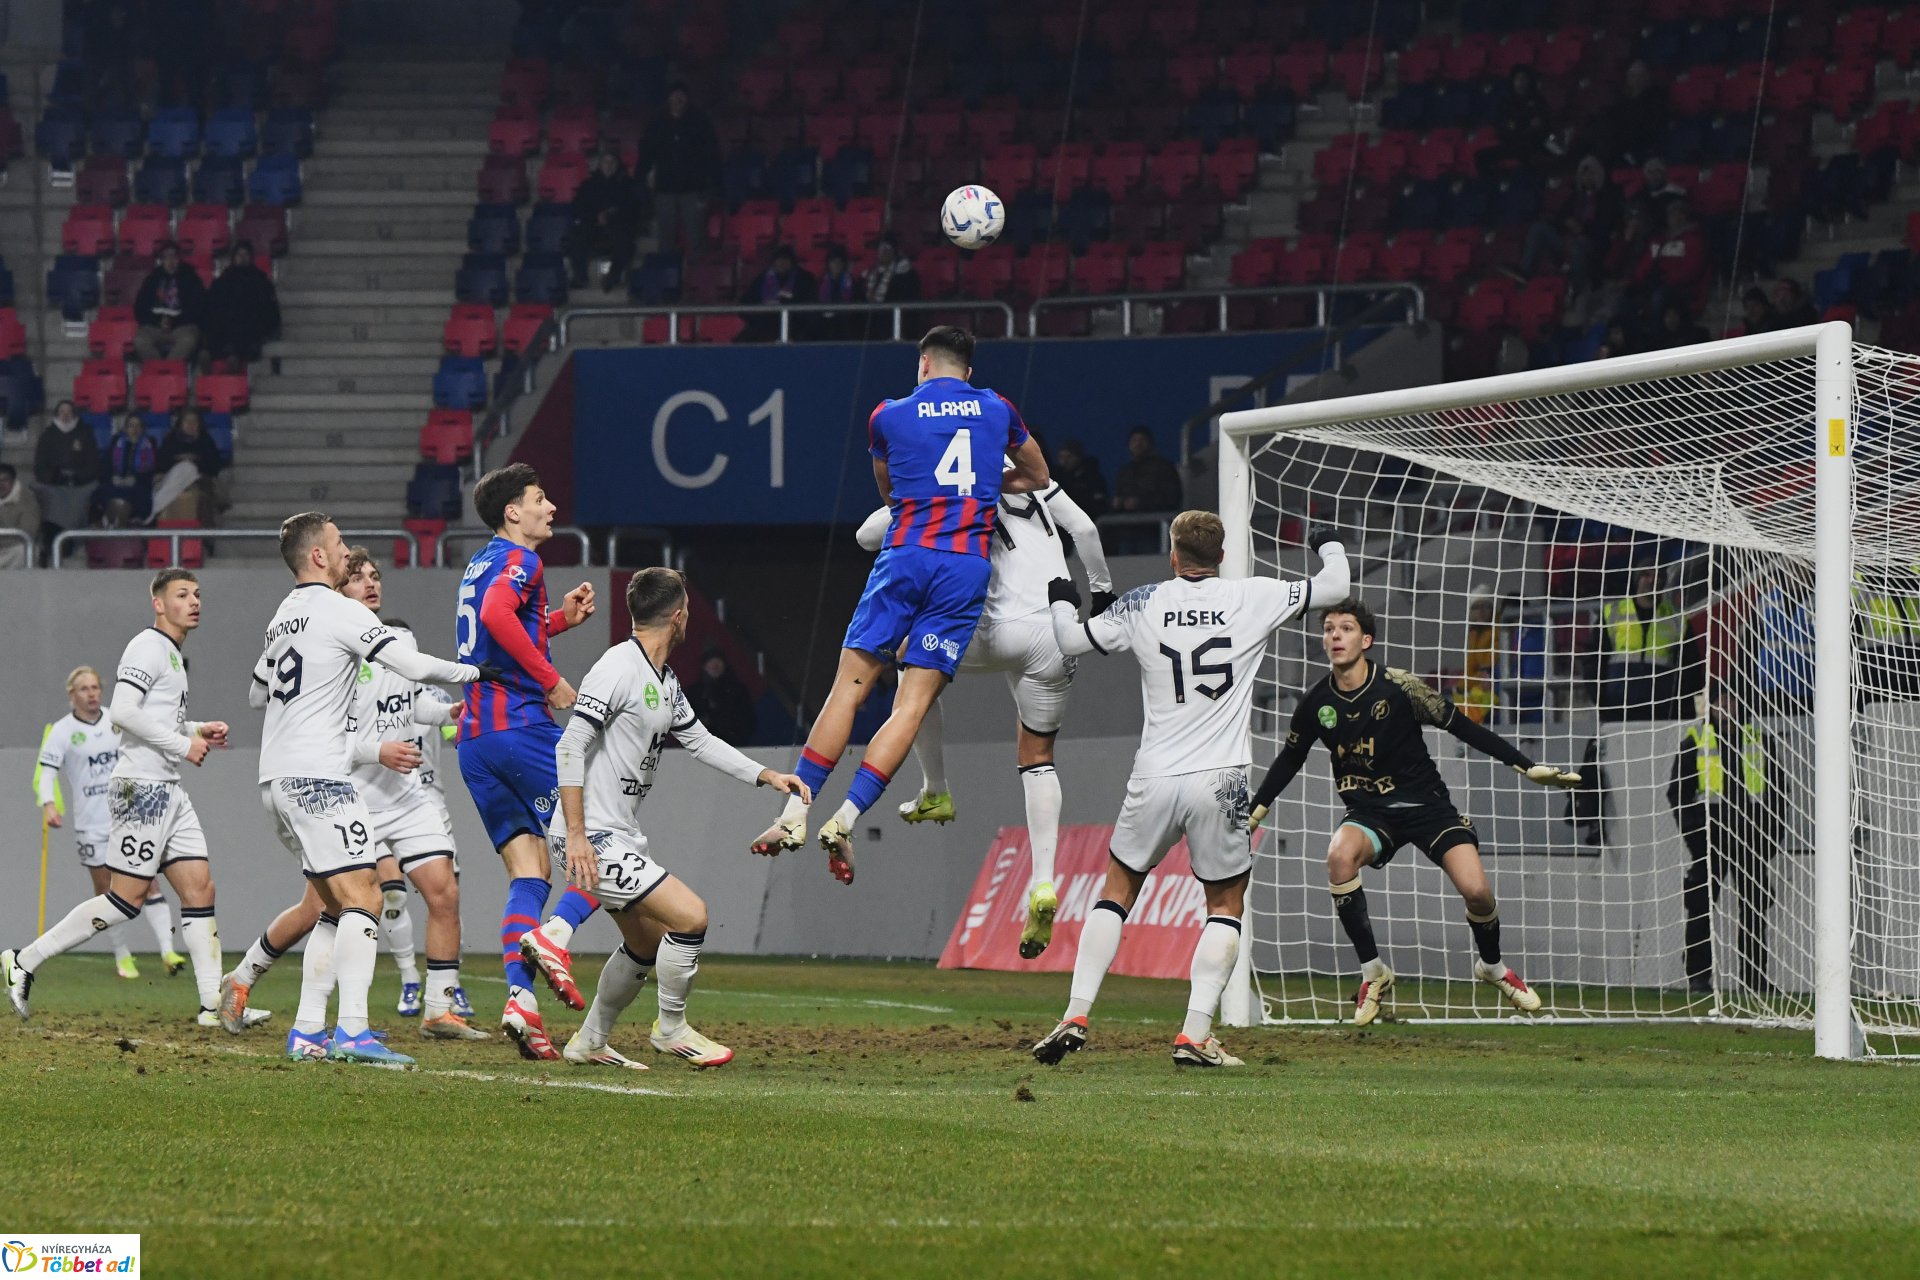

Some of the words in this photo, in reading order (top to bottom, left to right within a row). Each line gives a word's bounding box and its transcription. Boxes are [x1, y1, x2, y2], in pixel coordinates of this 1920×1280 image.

[917, 399, 982, 418] ALAXAI
[651, 388, 785, 490] C1
[934, 428, 976, 497] 4
[1163, 609, 1226, 628] PLSEK
[267, 645, 303, 706] 9
[1159, 636, 1234, 704] 15
[376, 713, 412, 733] BANK
[120, 834, 156, 862] 66
[333, 820, 369, 850] 19
[605, 852, 647, 890] 23
